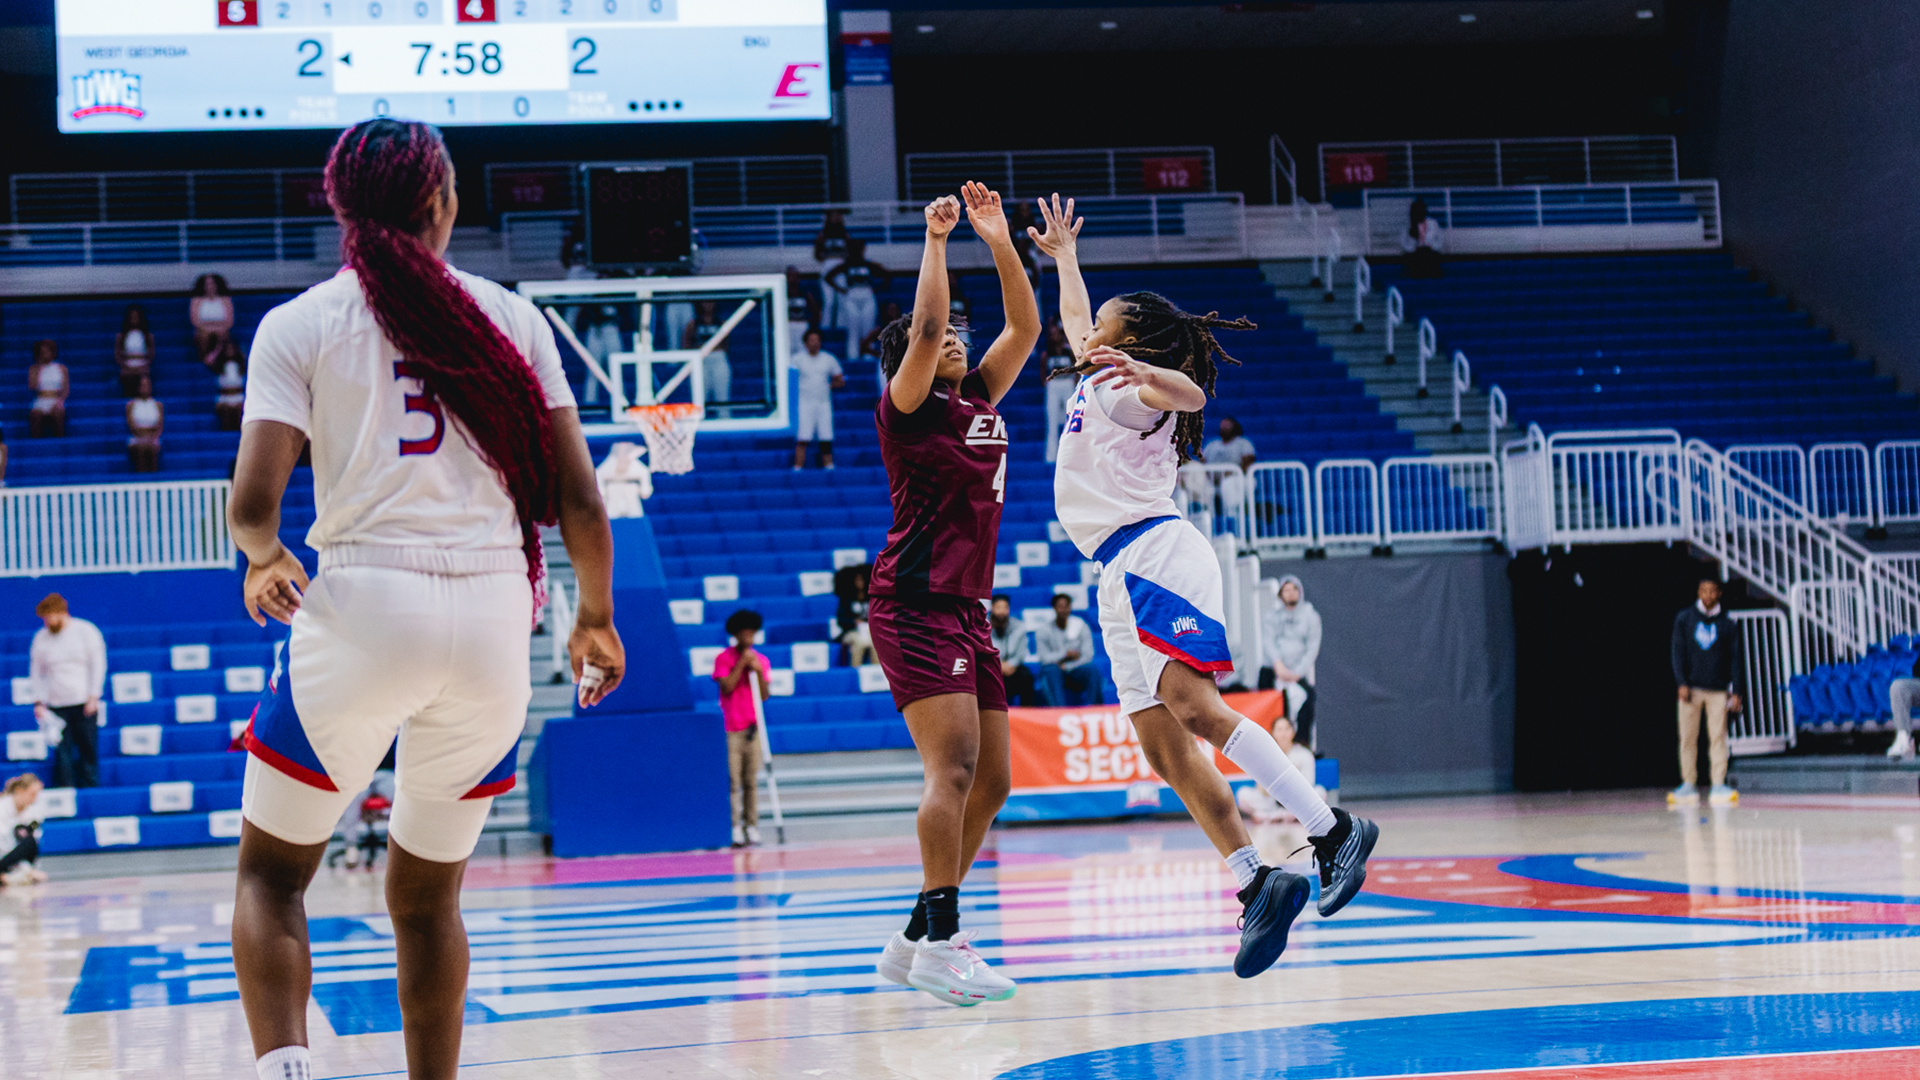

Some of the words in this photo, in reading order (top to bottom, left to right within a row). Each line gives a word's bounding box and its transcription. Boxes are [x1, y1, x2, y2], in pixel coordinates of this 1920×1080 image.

[366, 1, 383, 19] 0
[412, 1, 429, 19] 0
[297, 40, 323, 77] 2
[410, 41, 503, 76] 7:58
[571, 36, 598, 75] 2
[74, 70, 140, 109] UWG
[513, 96, 530, 117] 0
[393, 360, 445, 457] 3
[965, 414, 1009, 441] EK
[992, 452, 1007, 503] 4
[1171, 616, 1198, 634] UWG
[952, 658, 968, 672] E
